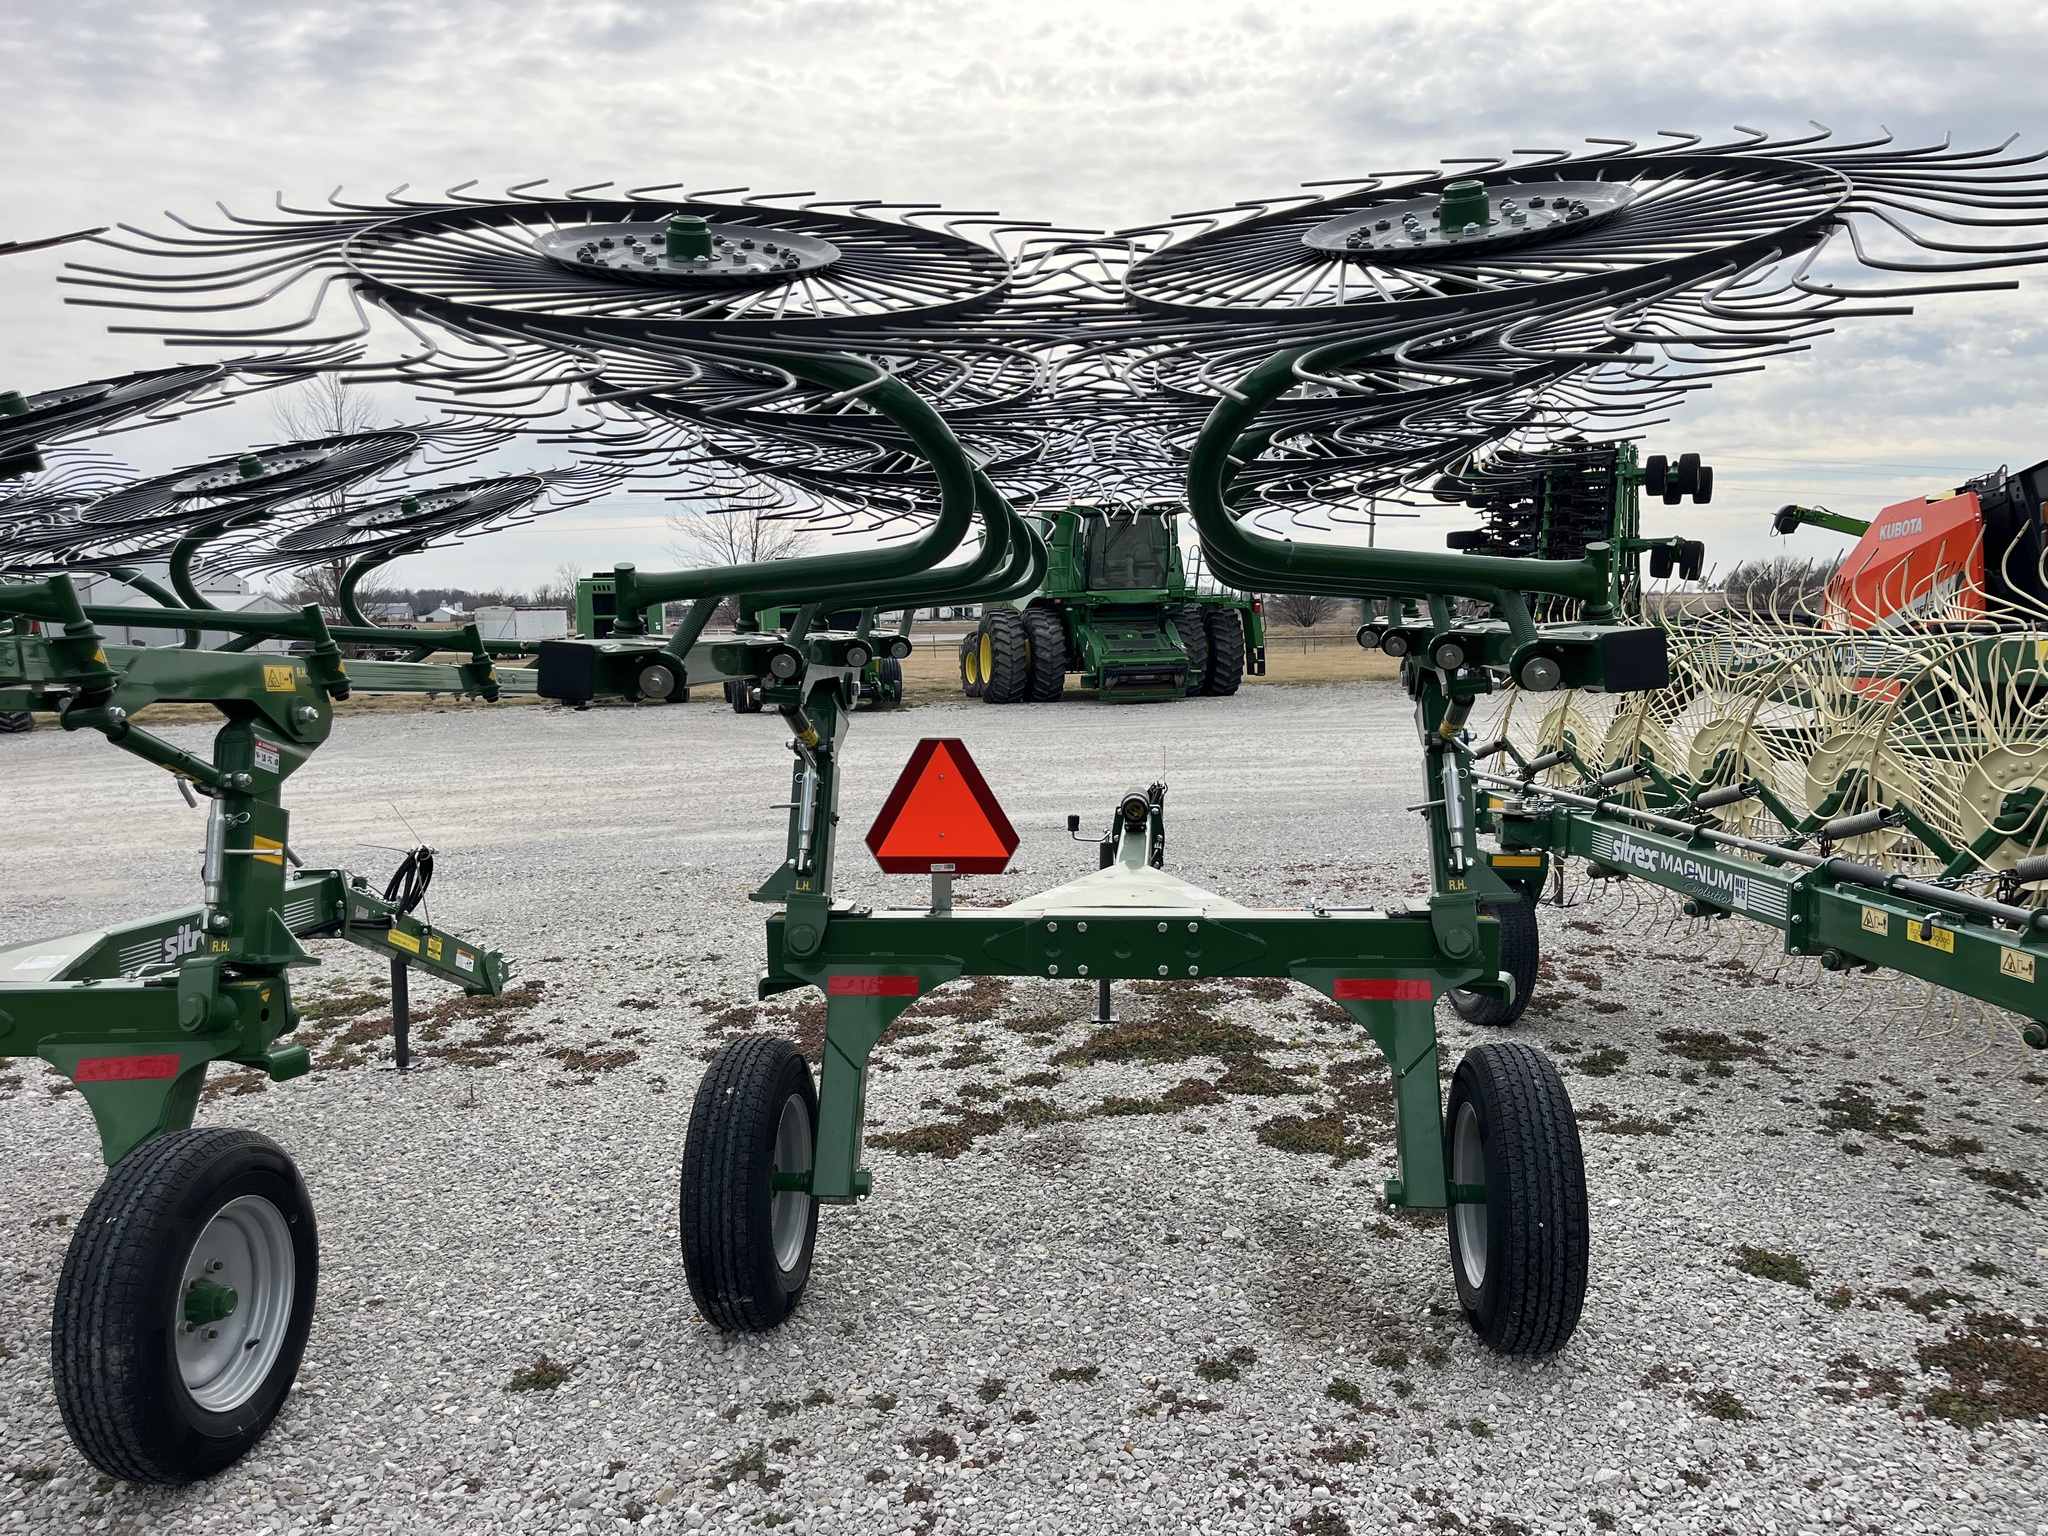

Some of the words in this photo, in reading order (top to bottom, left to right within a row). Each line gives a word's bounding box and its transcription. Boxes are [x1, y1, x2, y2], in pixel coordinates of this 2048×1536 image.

[1878, 516, 1923, 542] KUBOTA
[262, 742, 278, 752] DANGER
[1611, 833, 1659, 873] sitrex
[1660, 851, 1734, 892] MAGNUM
[795, 879, 811, 891] L.H.
[1448, 879, 1468, 890] R.H.
[1683, 880, 1735, 907] Evolution
[164, 924, 205, 964] sitr
[212, 940, 230, 952] R.H.
